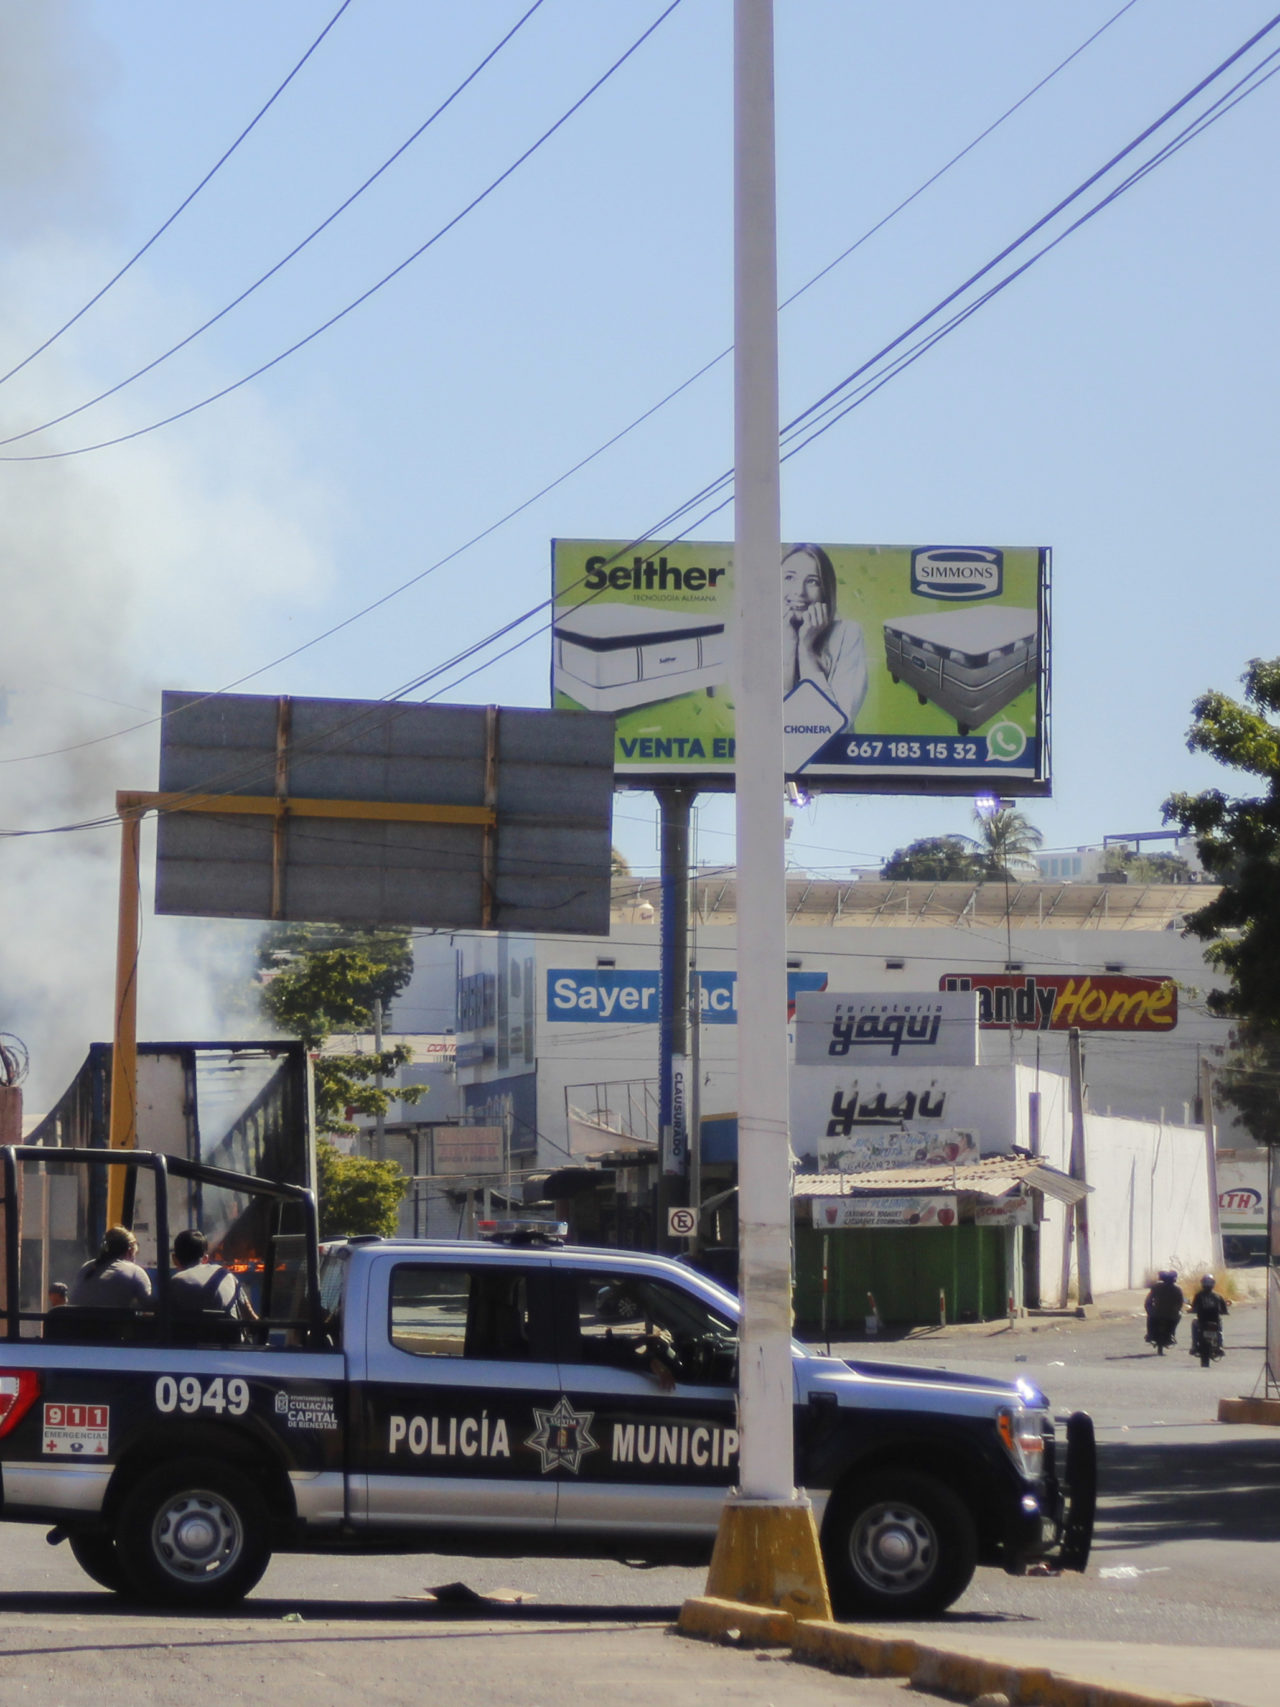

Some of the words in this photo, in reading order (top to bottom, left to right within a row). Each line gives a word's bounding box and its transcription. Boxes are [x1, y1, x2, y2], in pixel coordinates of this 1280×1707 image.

[585, 556, 725, 591] Selther
[921, 567, 993, 579] SIMMONS
[681, 594, 717, 602] ALEMANA
[619, 737, 706, 758] VENTA
[847, 741, 883, 758] 667
[888, 742, 921, 758] 183
[926, 743, 948, 759] 15
[953, 744, 976, 760] 32
[553, 978, 656, 1017] Sayer
[1052, 977, 1174, 1026] Home
[828, 1015, 942, 1056] yaqui
[426, 1043, 456, 1053] CONT
[673, 1072, 684, 1156] CLAUSURADO
[1218, 1194, 1252, 1208] LTH
[155, 1376, 250, 1415] 0949
[289, 1400, 334, 1411] CULIACÁN
[48, 1406, 103, 1425] 911
[288, 1410, 338, 1423] CAPITAL
[298, 1421, 338, 1429] BIENESTAR
[44, 1430, 109, 1440] EMERGENCIAS
[389, 1410, 510, 1458] POLICÍA
[612, 1423, 740, 1468] MUNICIP
